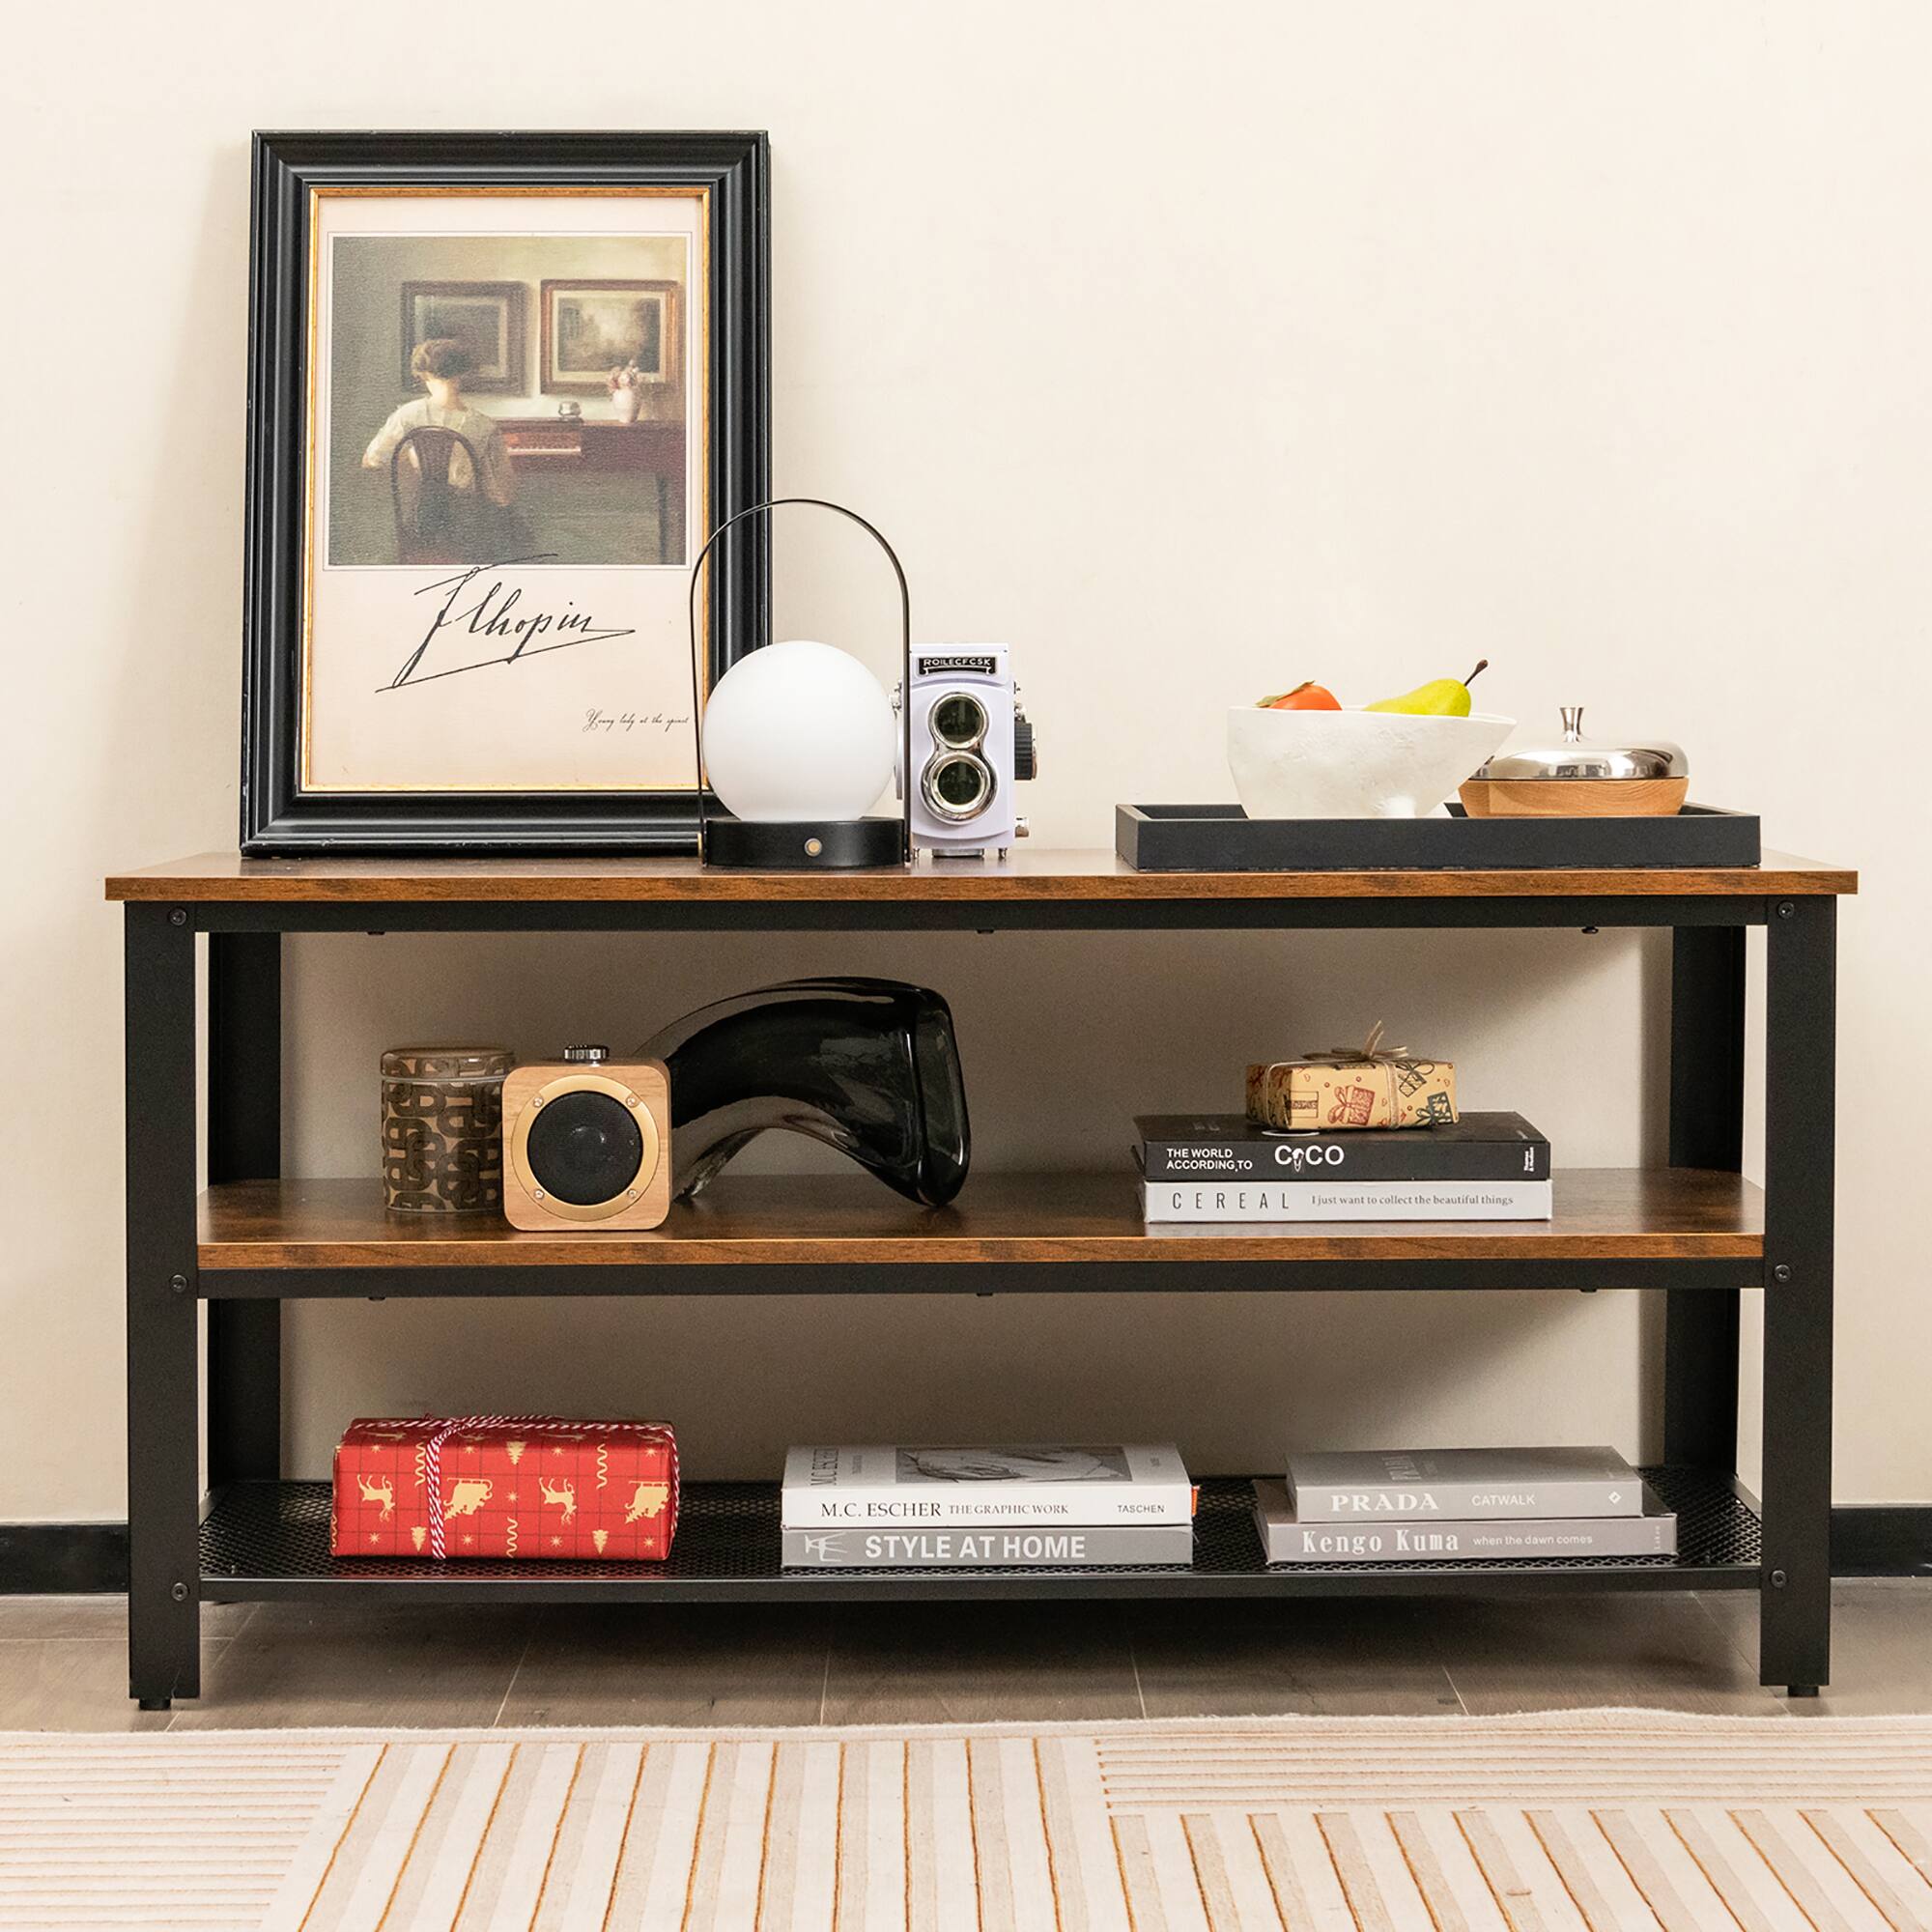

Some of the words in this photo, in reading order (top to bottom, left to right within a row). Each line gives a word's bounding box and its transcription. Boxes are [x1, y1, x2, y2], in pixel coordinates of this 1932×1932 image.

[1167, 1148, 1189, 1158] THE
[1191, 1148, 1233, 1158] WORLD
[1172, 1192, 1290, 1209] CEREAL
[1311, 1195, 1317, 1205] I
[1318, 1195, 1337, 1207] just
[1339, 1196, 1365, 1205] want
[1367, 1196, 1378, 1205] to
[1378, 1194, 1412, 1205] collect
[1414, 1194, 1431, 1205] the
[1433, 1194, 1479, 1205] beautiful
[1481, 1194, 1514, 1207] things
[1330, 1493, 1439, 1513] PRADA
[1470, 1493, 1536, 1507] CATWALK
[821, 1502, 862, 1518] M.C.
[867, 1502, 942, 1518] ESCHER
[949, 1504, 973, 1515] THE
[974, 1504, 1029, 1515] GRAPHIC
[1031, 1504, 1068, 1515] WORK
[1117, 1504, 1165, 1514] TASCHEN
[865, 1535, 952, 1559] STYLE
[958, 1536, 996, 1559] AT
[1003, 1535, 1086, 1559] HOME
[1302, 1530, 1382, 1554] Kengo
[1396, 1529, 1459, 1551] Kuma
[1472, 1536, 1503, 1547] when
[1504, 1535, 1522, 1546] the
[1524, 1535, 1552, 1546] dawn
[1554, 1535, 1594, 1546] comes
